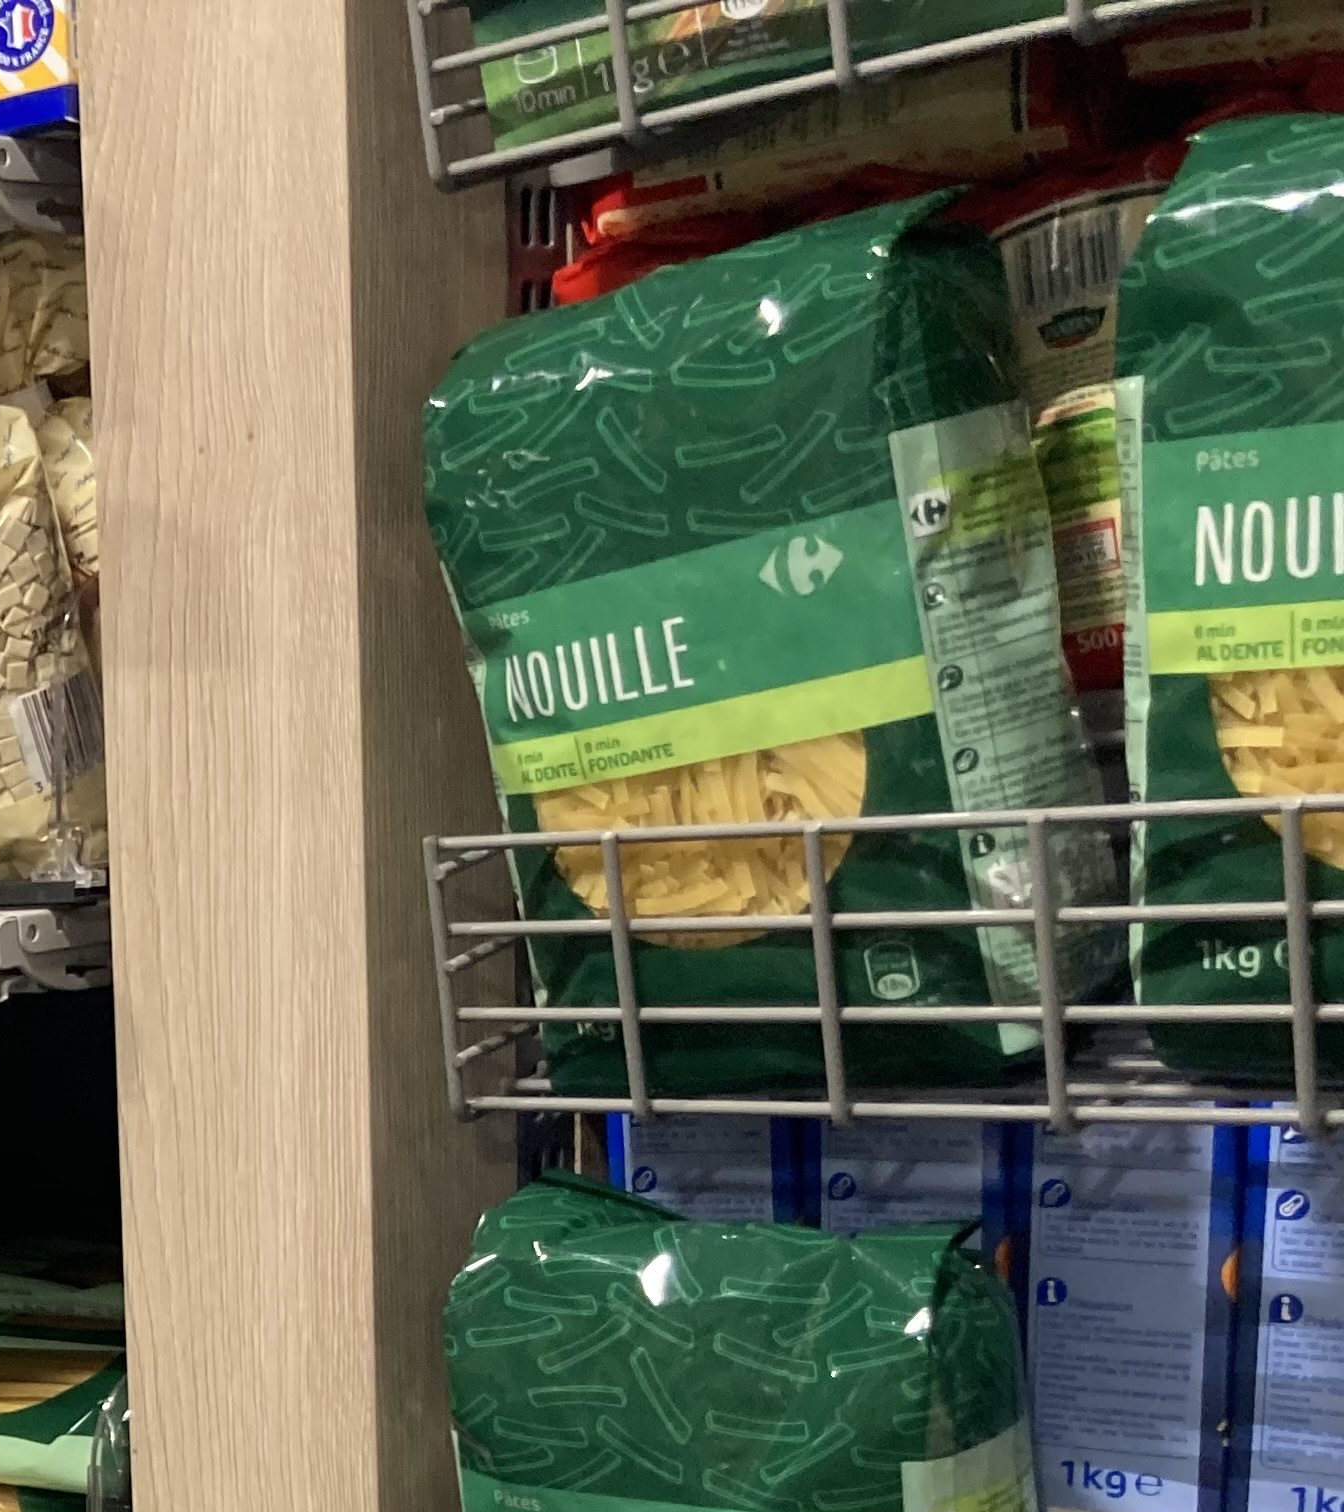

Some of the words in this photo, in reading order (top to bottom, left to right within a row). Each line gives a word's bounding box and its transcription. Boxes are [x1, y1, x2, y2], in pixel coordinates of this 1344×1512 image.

[1196, 446, 1259, 471] Pâtes
[504, 616, 695, 723] NOUILLE
[1196, 641, 1221, 661] AL
[1222, 639, 1284, 660] DENTE
[535, 763, 578, 782] DENTE
[588, 742, 674, 774] FONDANTE
[1201, 938, 1260, 977] 1kg
[1062, 1458, 1128, 1499] 1kg
[494, 1488, 541, 1512] Pâtes
